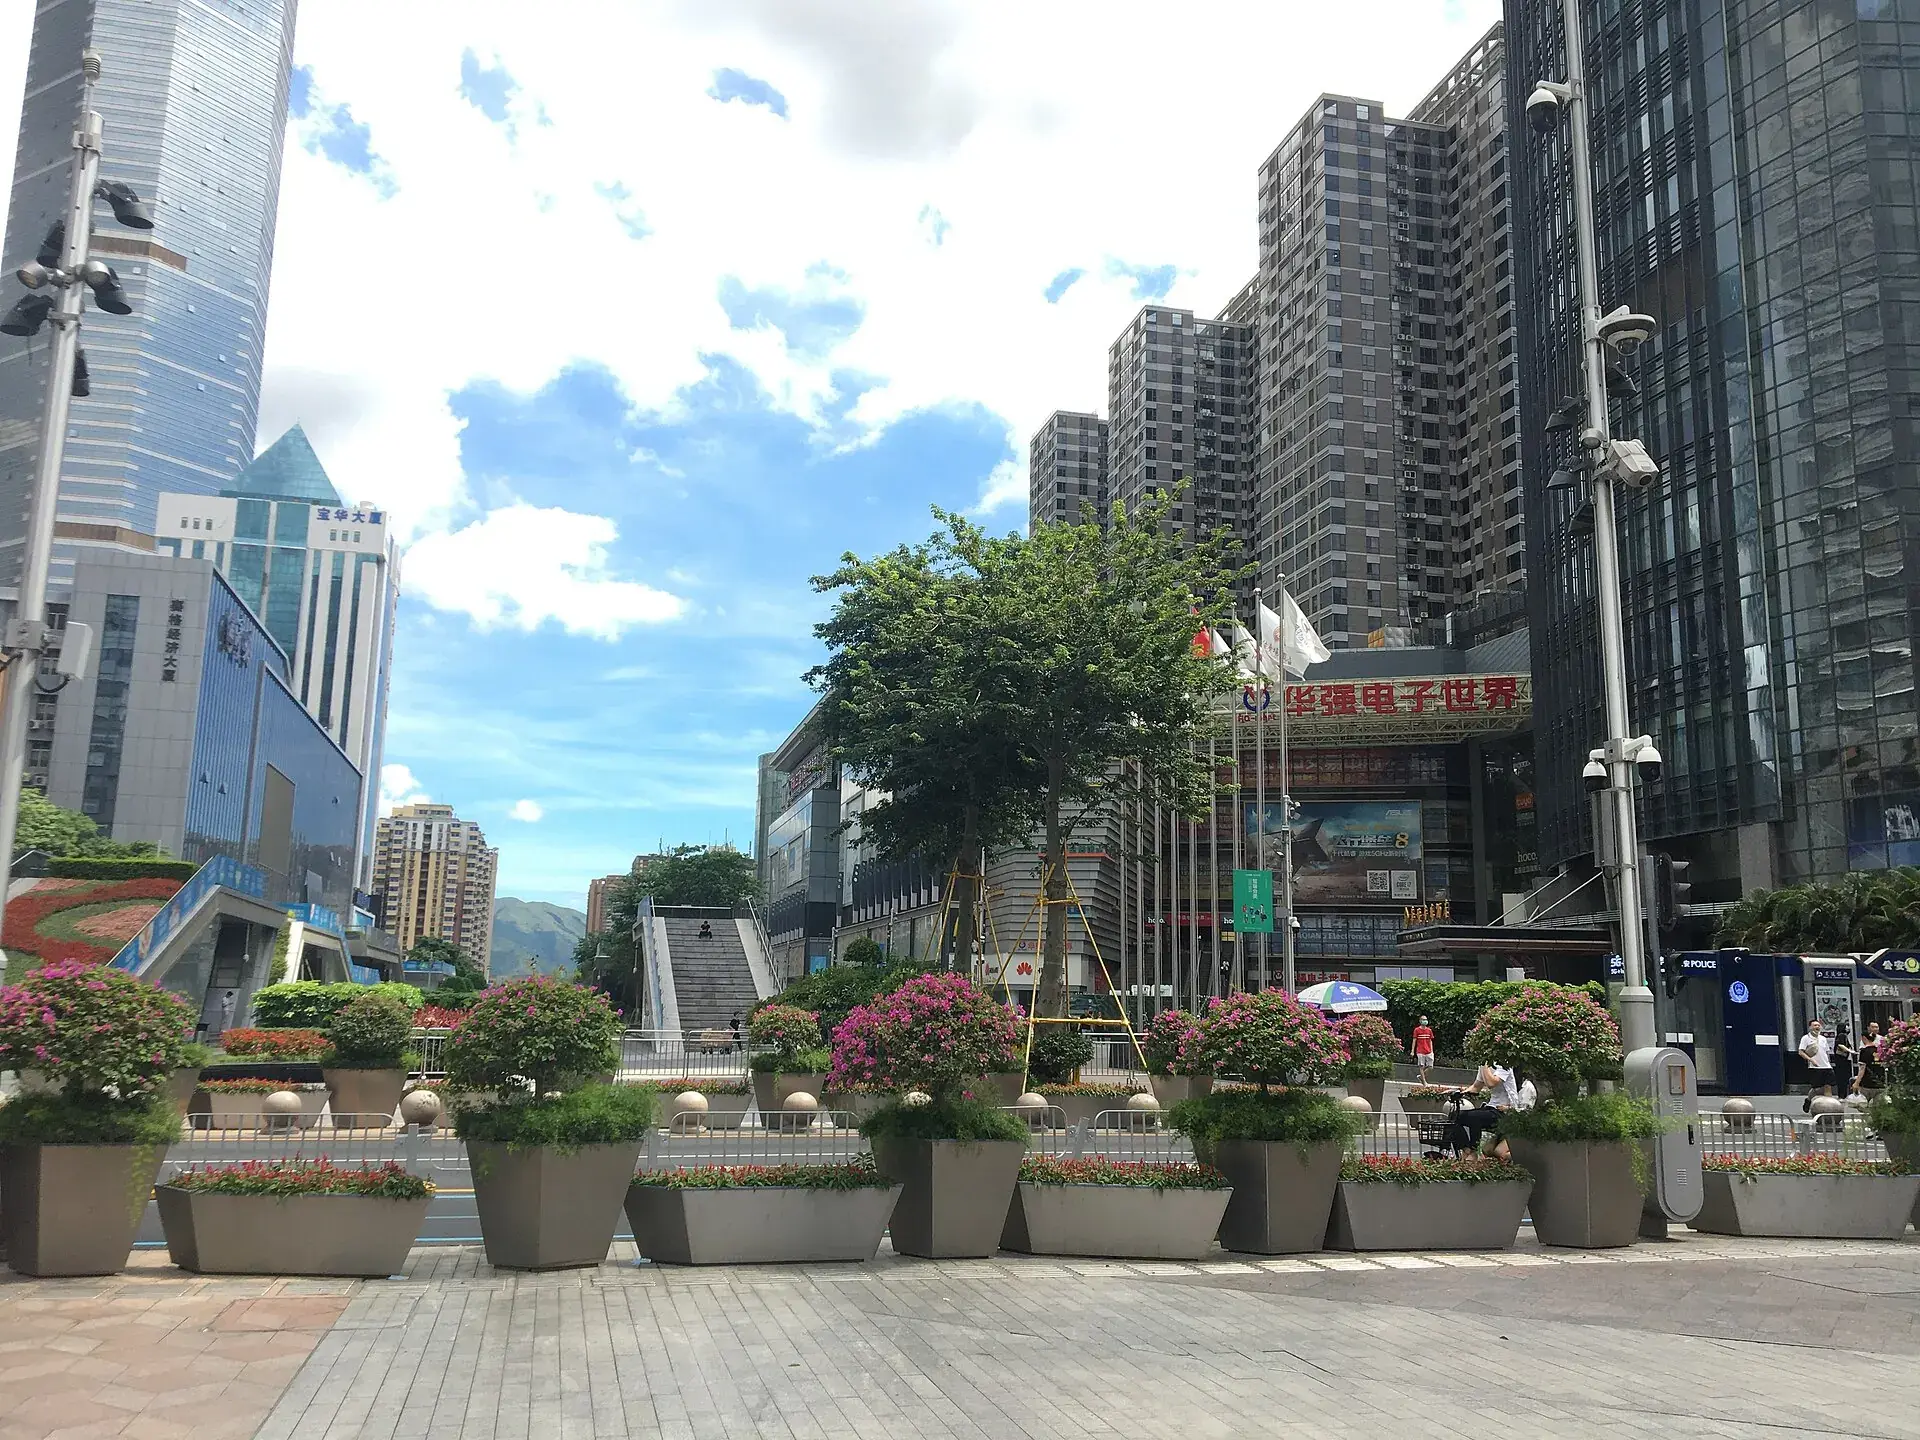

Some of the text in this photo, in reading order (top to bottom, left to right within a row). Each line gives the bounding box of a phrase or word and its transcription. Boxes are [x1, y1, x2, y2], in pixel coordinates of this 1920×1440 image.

[316, 507, 382, 525] 宝华大厦
[161, 599, 184, 682] 赛格经济大厦
[1285, 677, 1520, 717] 华强电子世界
[1690, 960, 1717, 968] POLICE
[1882, 959, 1905, 971] 公安
